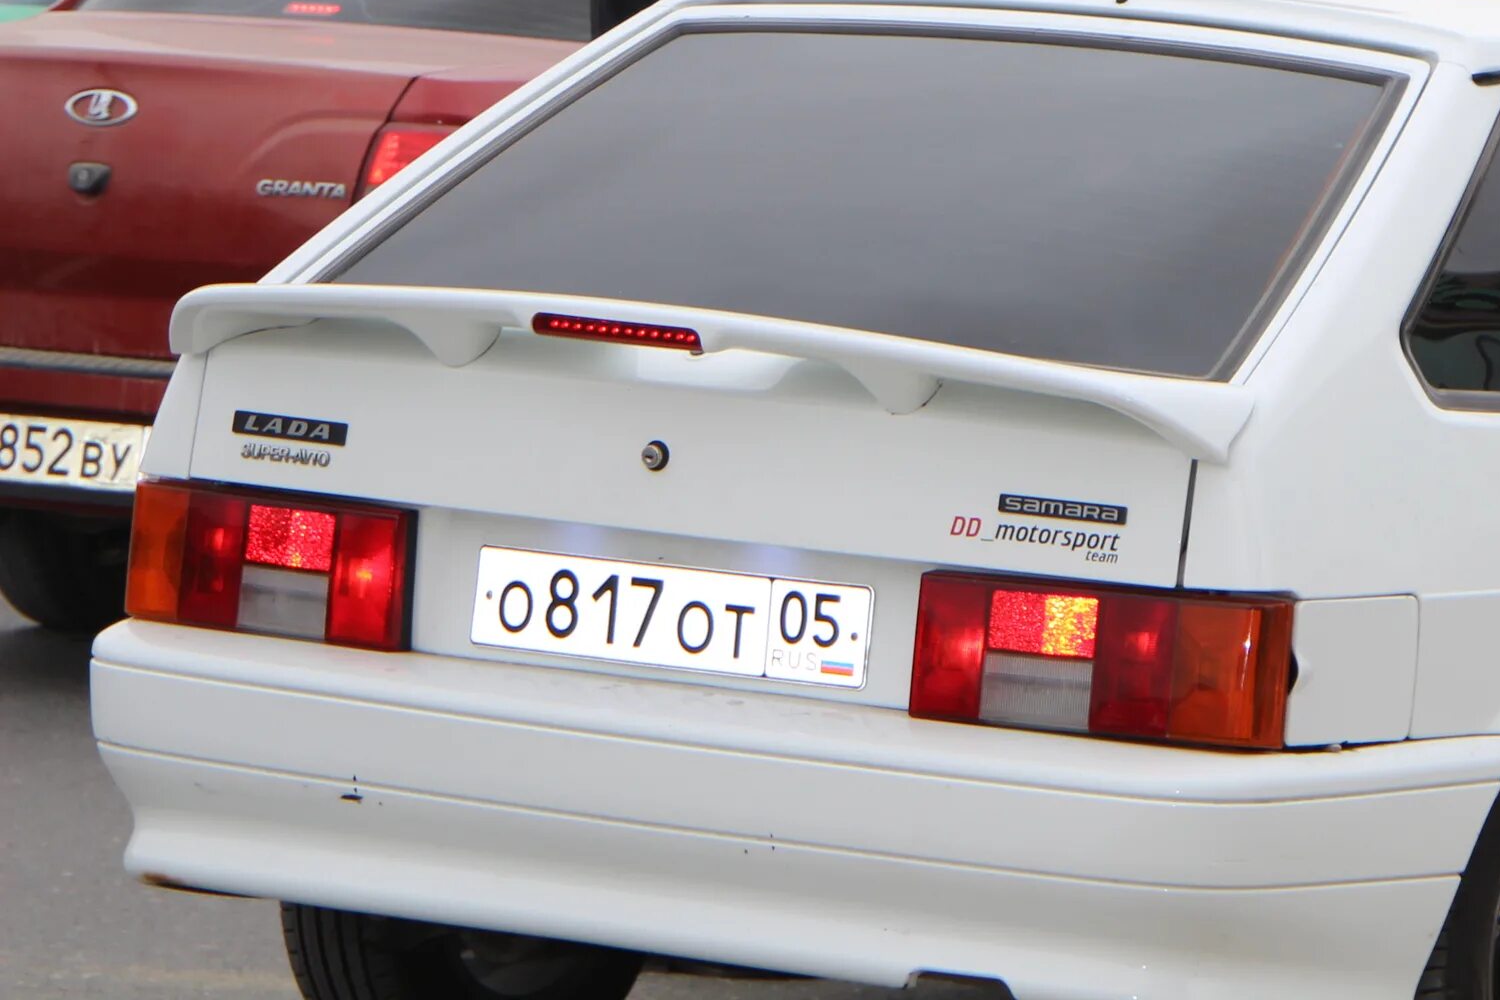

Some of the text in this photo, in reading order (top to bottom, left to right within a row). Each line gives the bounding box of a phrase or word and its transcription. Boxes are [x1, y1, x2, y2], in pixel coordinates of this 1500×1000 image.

[256, 179, 346, 199] GRANTA
[244, 415, 331, 440] LADA
[1085, 550, 1119, 564] team
[780, 590, 840, 648] 05
[771, 648, 817, 672] RUS
